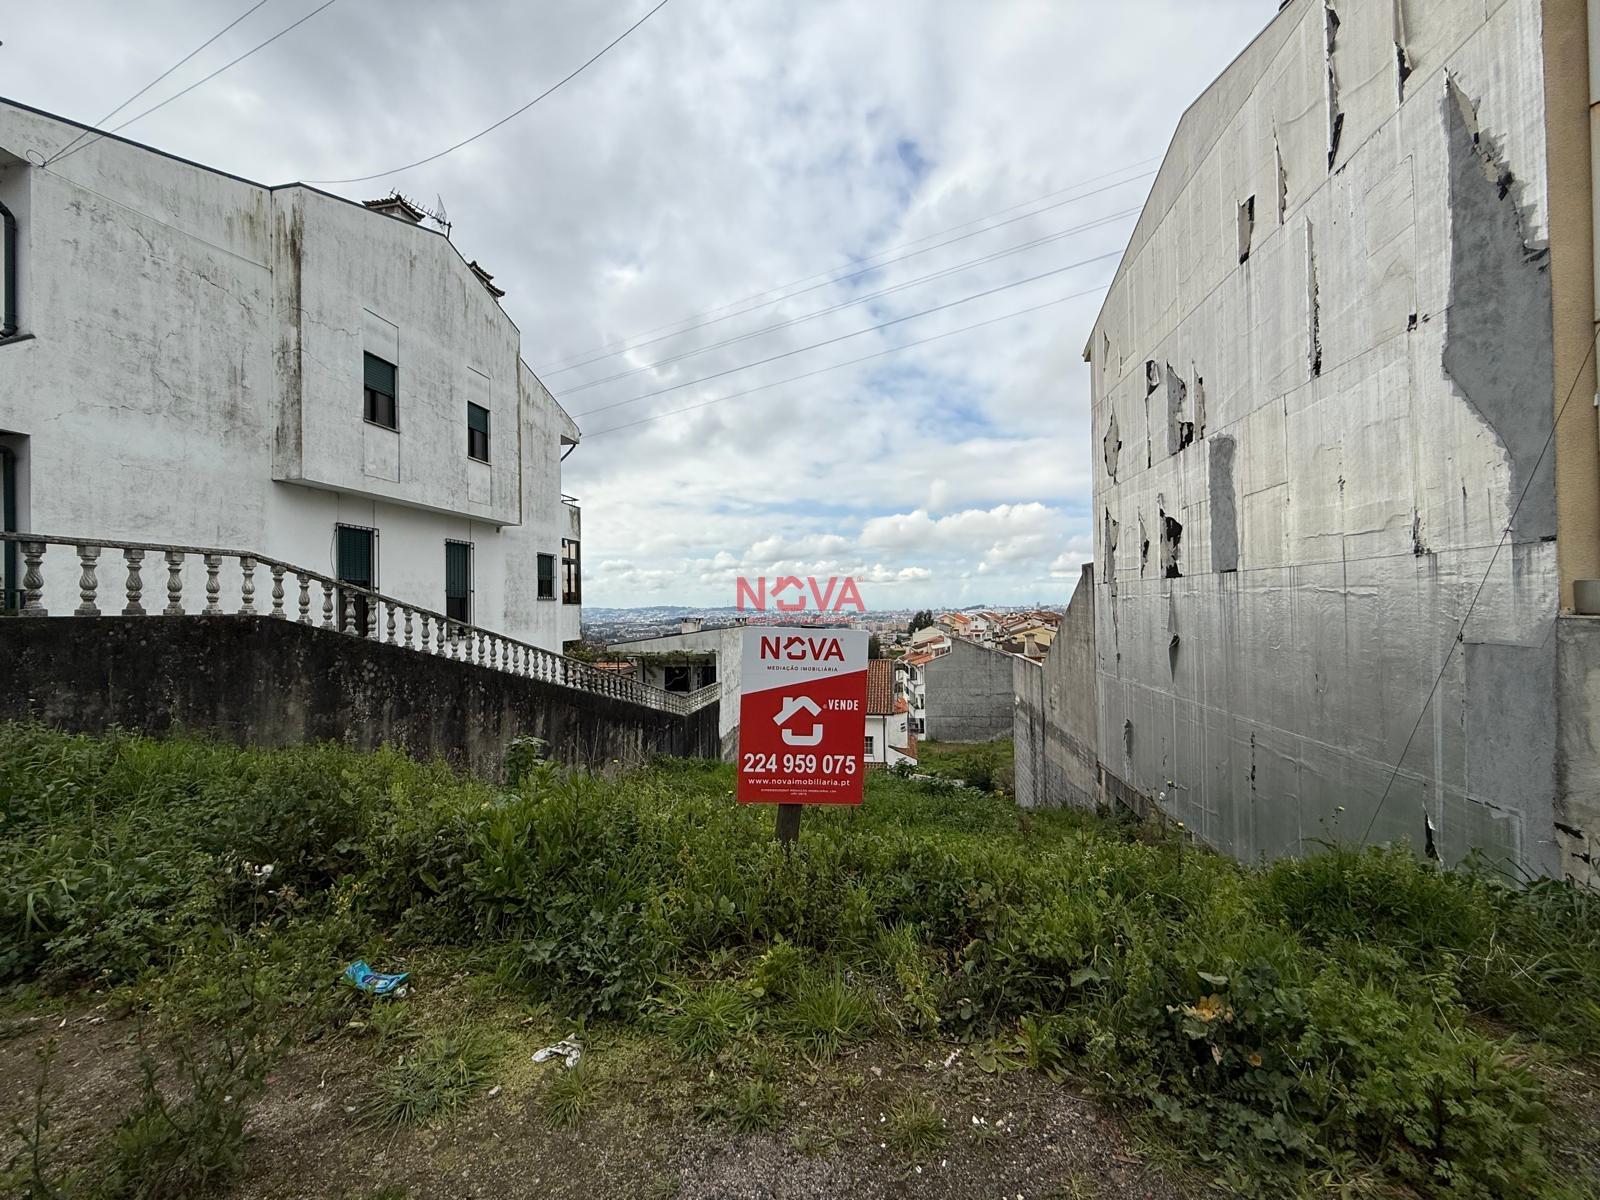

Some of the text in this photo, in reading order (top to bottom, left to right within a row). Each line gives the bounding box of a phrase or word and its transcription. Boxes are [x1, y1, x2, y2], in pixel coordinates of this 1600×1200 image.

[760, 636, 845, 661] NOVA
[828, 699, 859, 711] VENDE
[743, 753, 856, 775] 224 959 075
[748, 778, 850, 787] www.novaimobiliaria.pt
